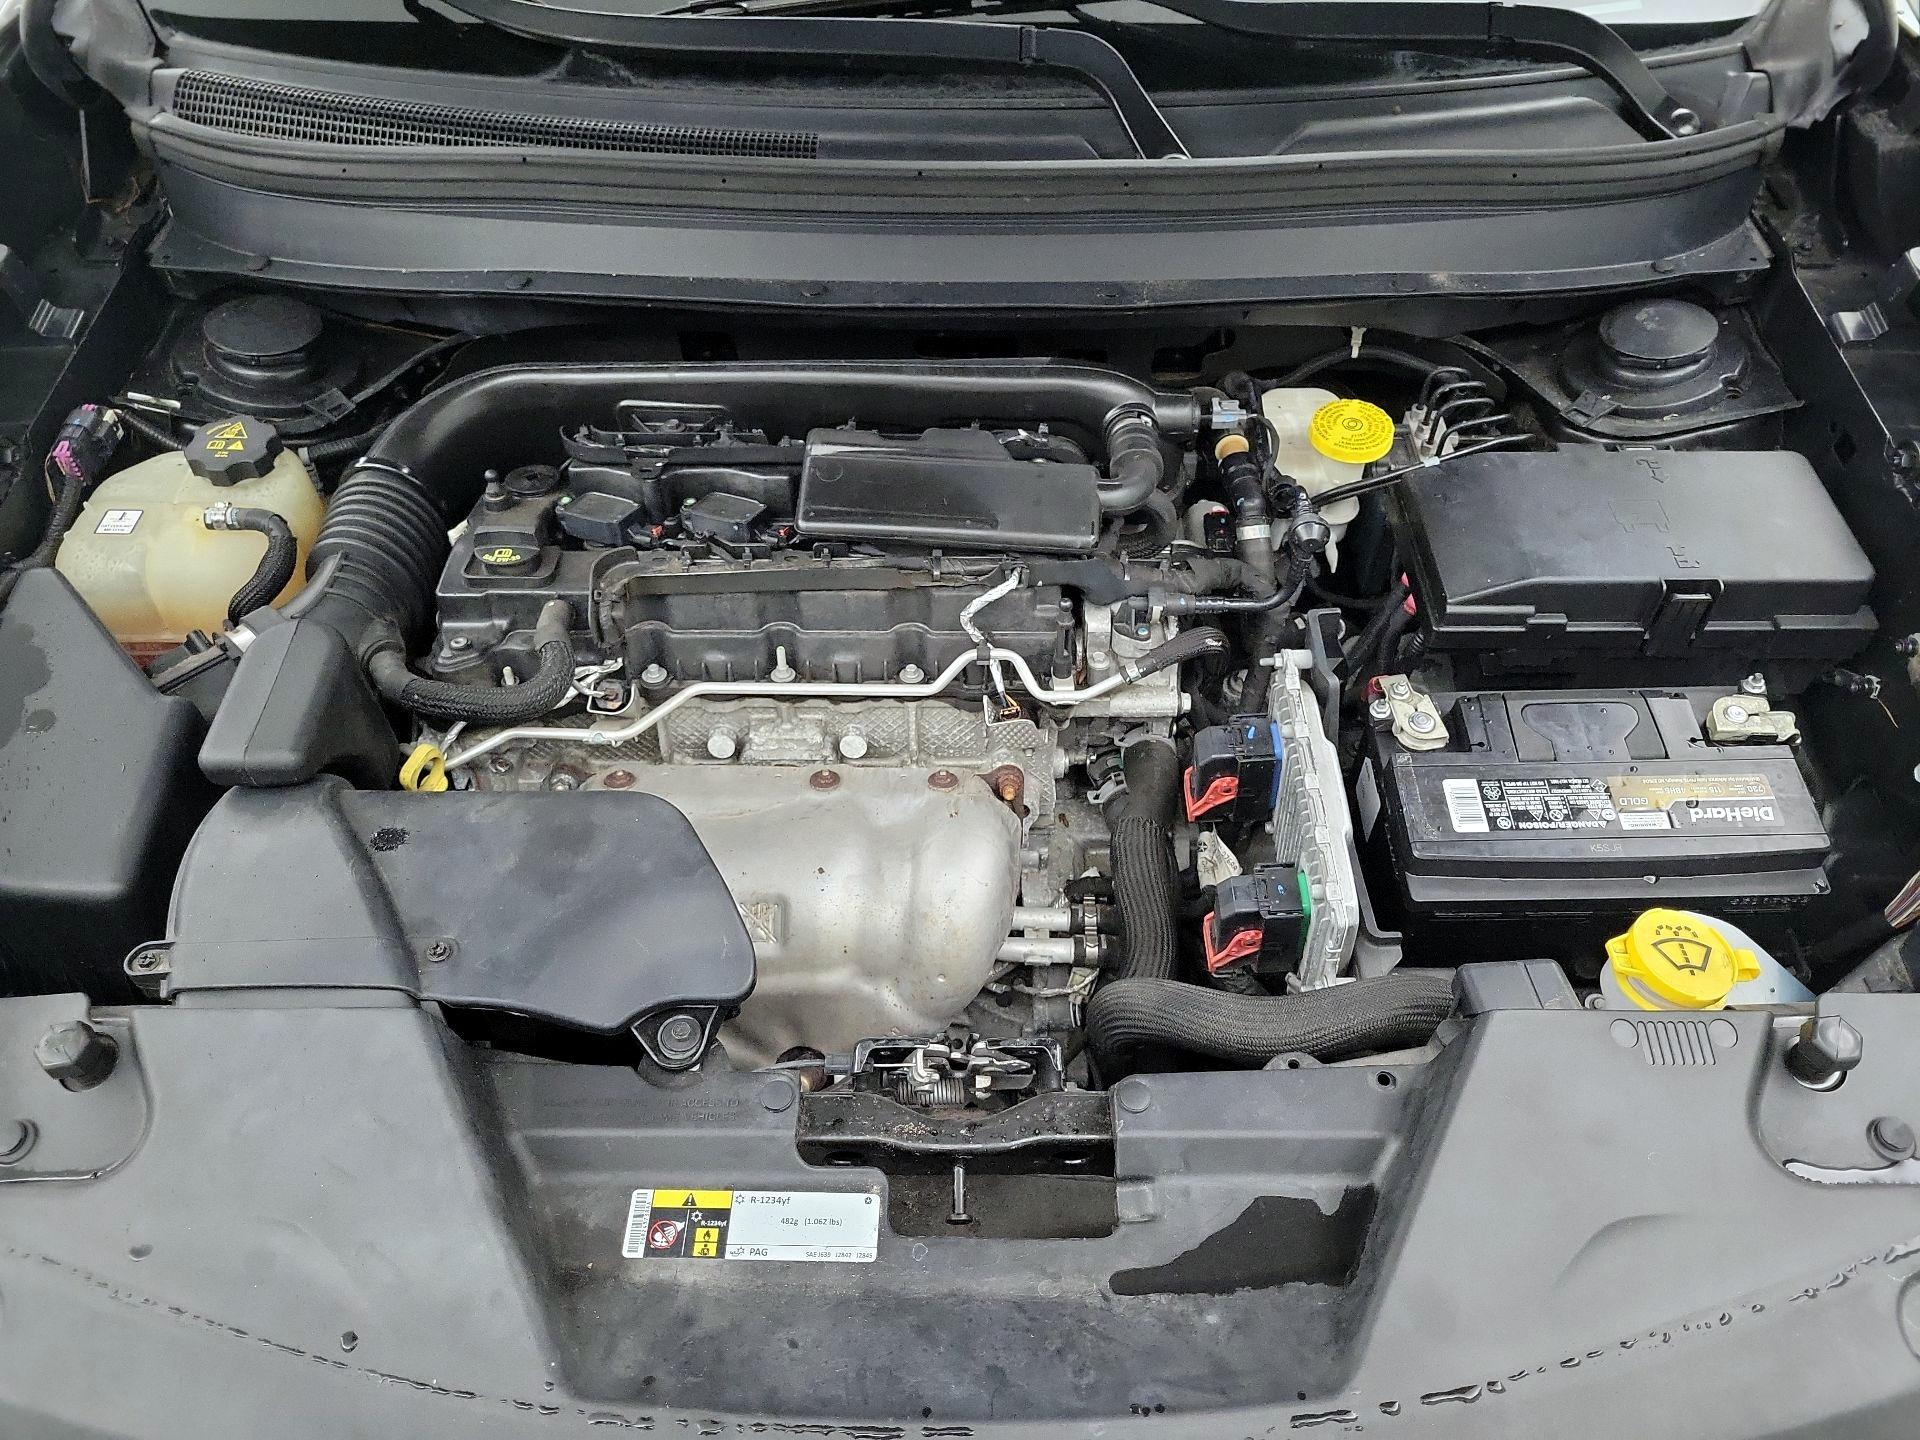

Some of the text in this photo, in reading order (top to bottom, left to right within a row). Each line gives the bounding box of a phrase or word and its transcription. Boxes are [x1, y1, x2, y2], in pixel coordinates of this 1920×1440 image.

[1619, 797, 1648, 806] GOLD
[1689, 806, 1775, 822] DieHard
[1519, 820, 1600, 830] DANGER/POISON
[750, 1196, 791, 1207] R-1234yf
[780, 1217, 799, 1226] 482g
[749, 1247, 769, 1257] PAG
